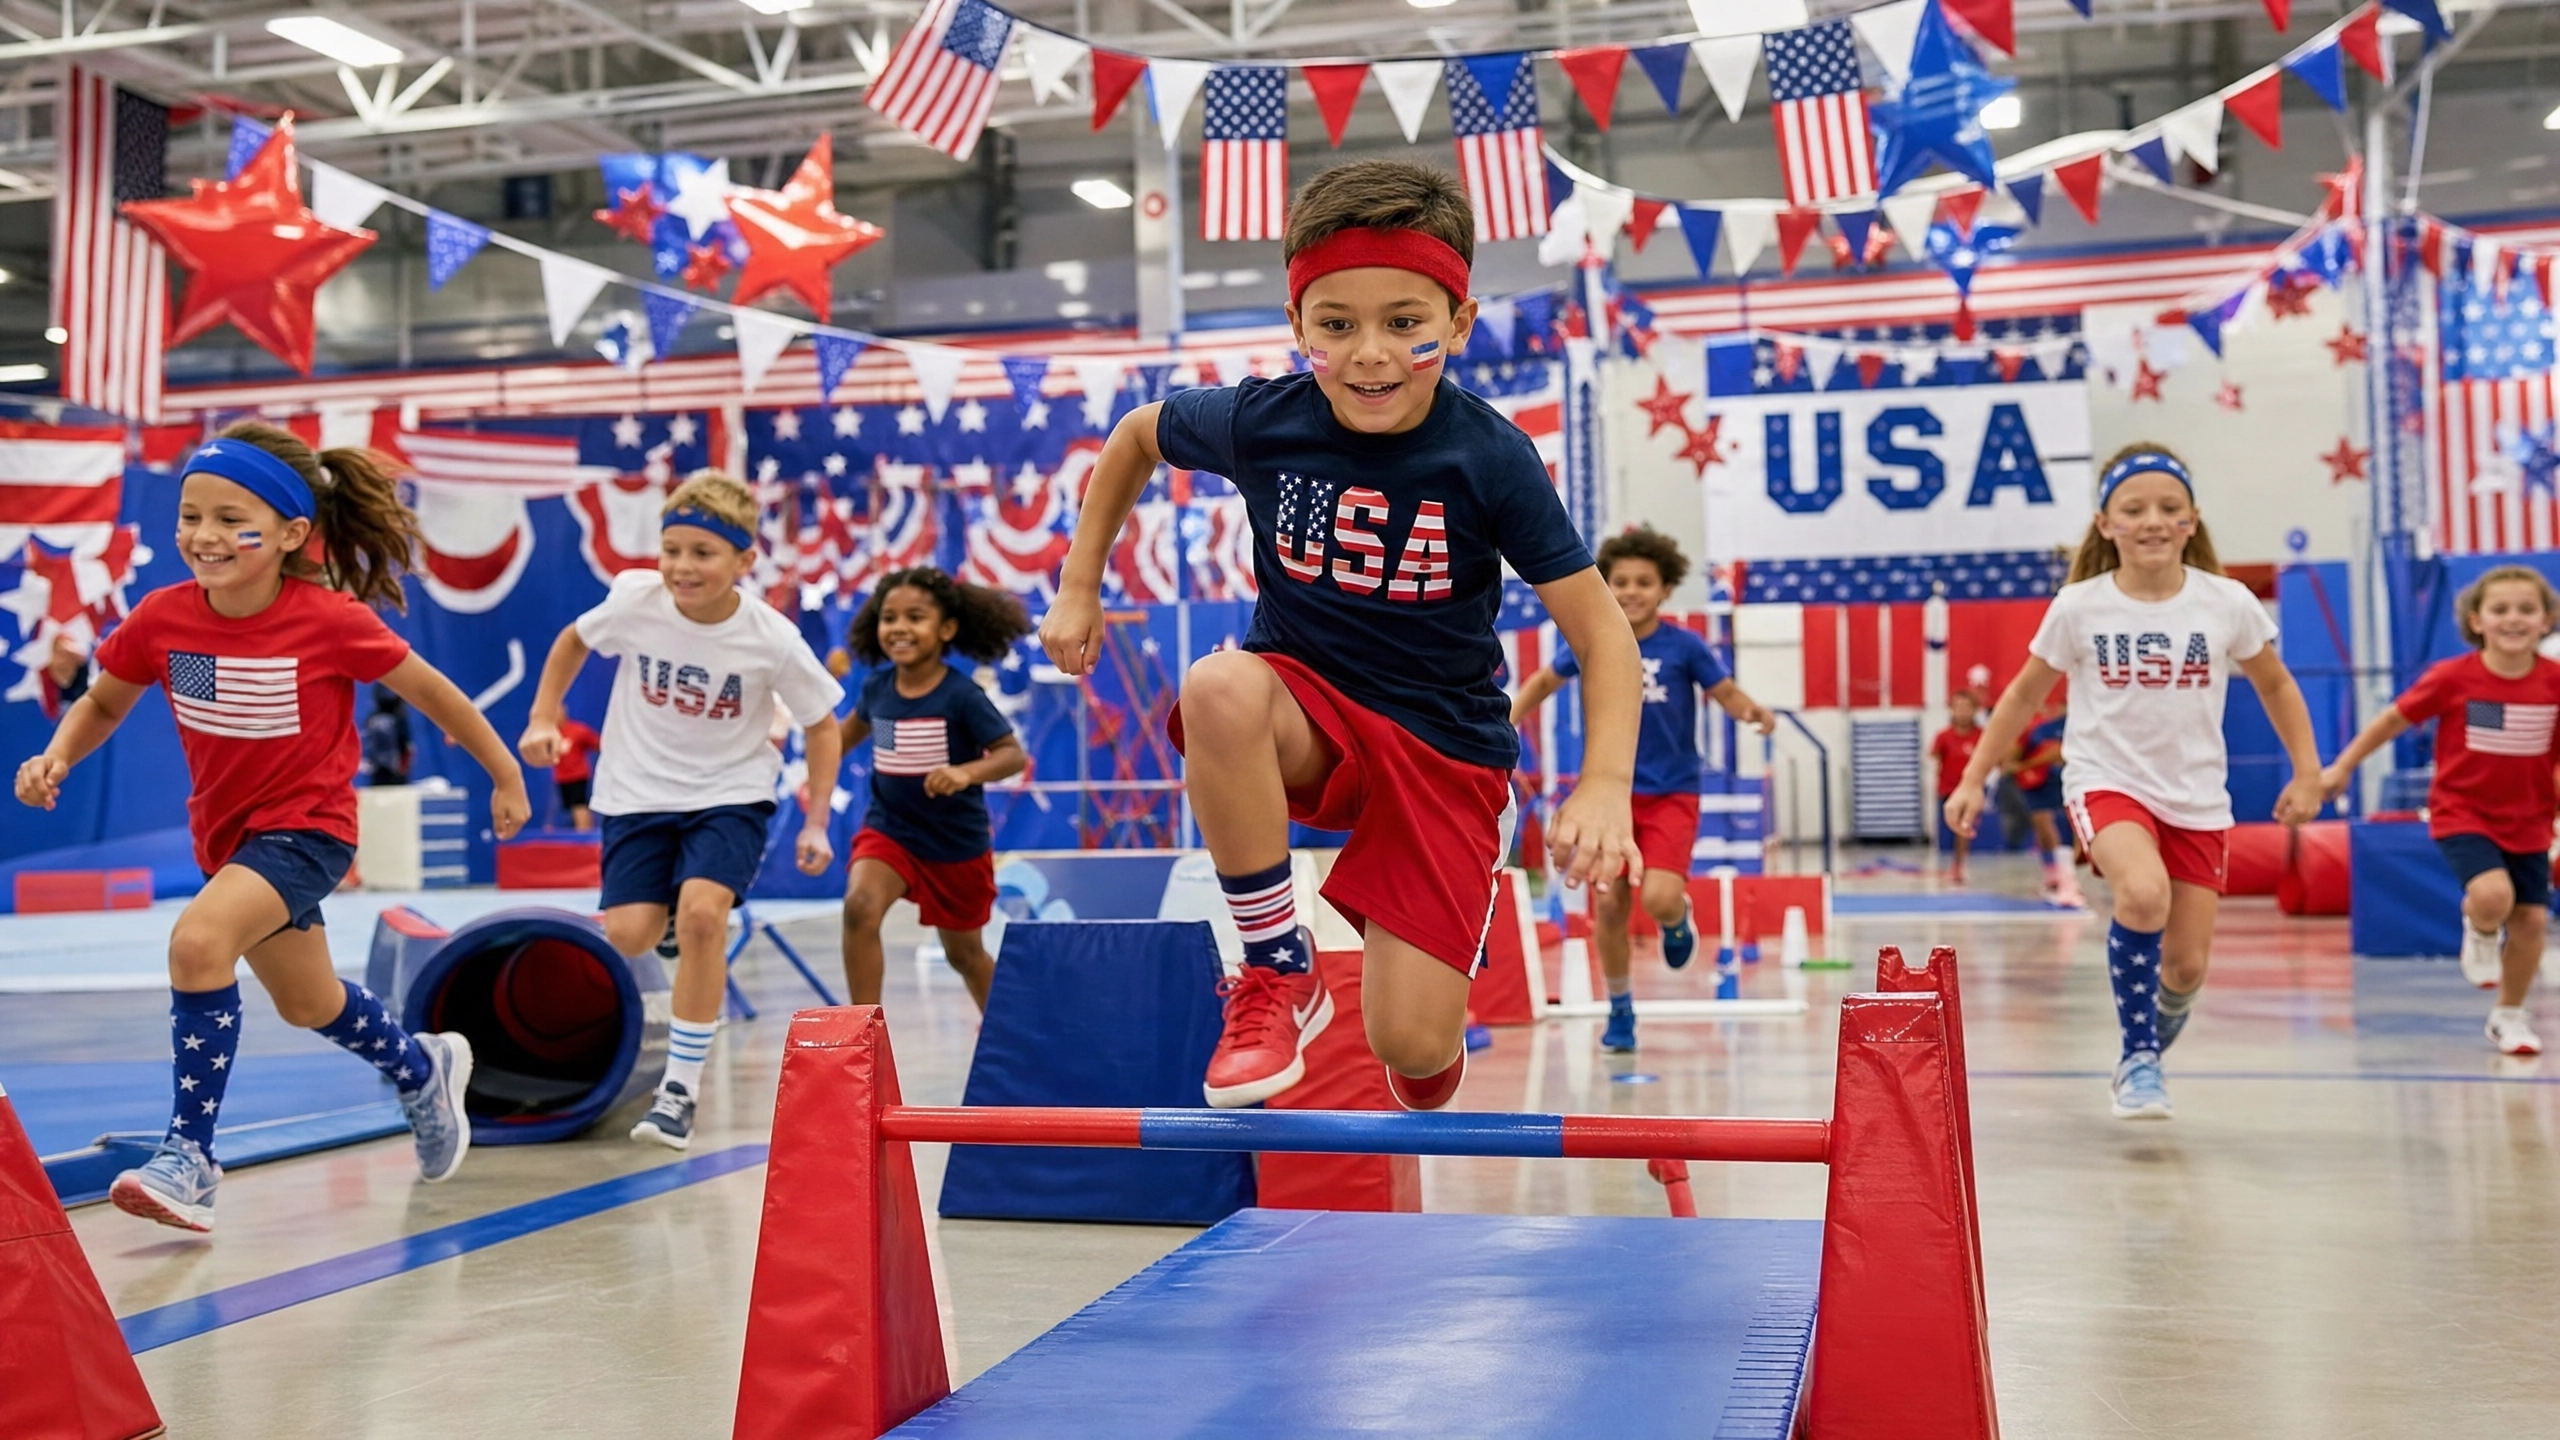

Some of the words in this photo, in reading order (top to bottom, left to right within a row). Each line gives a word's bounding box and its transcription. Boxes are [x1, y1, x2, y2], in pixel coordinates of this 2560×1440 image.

[1765, 404, 2054, 513] USA
[1276, 469, 1453, 600] USA
[639, 653, 742, 720] USA
[2093, 632, 2210, 688] USA
